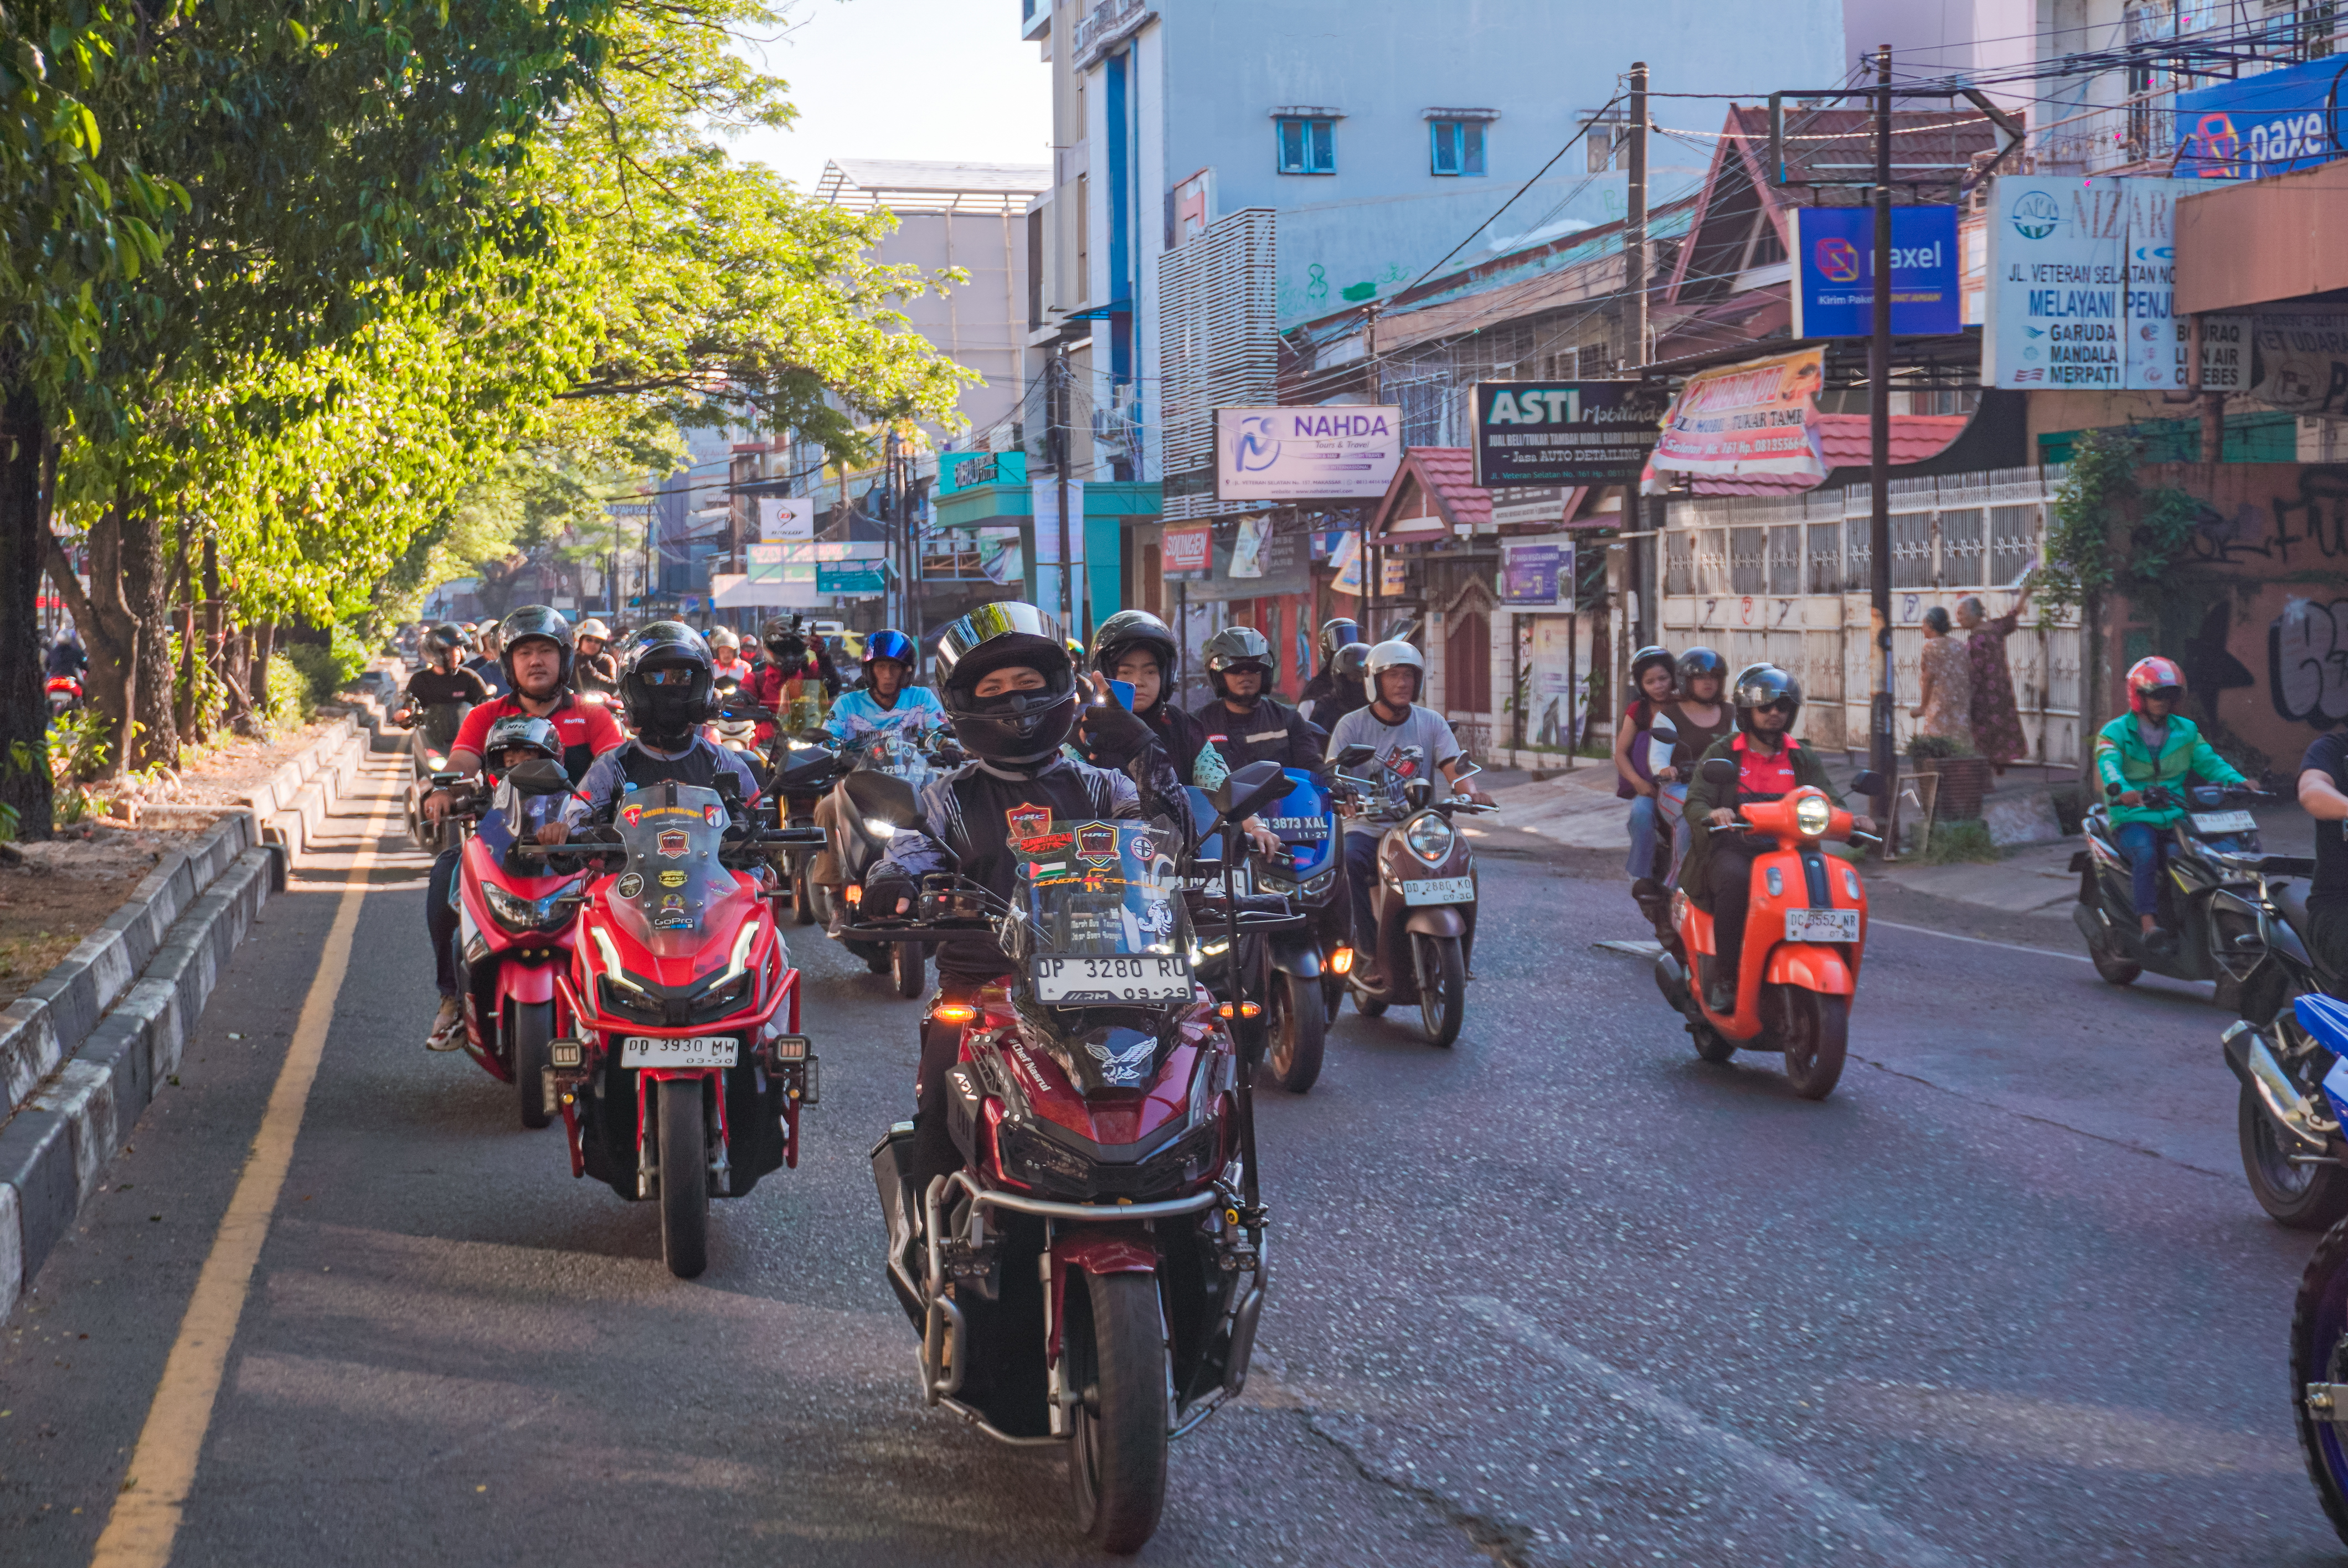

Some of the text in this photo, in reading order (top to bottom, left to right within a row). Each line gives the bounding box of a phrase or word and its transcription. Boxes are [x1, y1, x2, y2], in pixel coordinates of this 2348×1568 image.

[2031, 264, 2090, 283] VETERAN
[2094, 265, 2155, 284] SELATAN
[1818, 295, 1846, 305] Kirim
[2028, 289, 2117, 318] MELAYANI
[2050, 323, 2118, 342] GARUDA
[2050, 345, 2119, 364] MANDALA
[2216, 348, 2239, 366] AIR
[2050, 365, 2120, 384] MERPATI
[1486, 388, 1580, 425] ASTI
[1295, 415, 1390, 437] NAHDA
[1316, 440, 1371, 449] Tours & Travel
[1489, 434, 1506, 447] JUAL
[1551, 433, 1579, 446] TAMBAH
[1579, 432, 1602, 445] MOBIL
[1665, 439, 1702, 455] Selatan
[1512, 448, 1641, 463] Jasa AUTO DETAILING
[1502, 471, 1532, 479] Veteran
[1533, 470, 1562, 479] Selatan
[1165, 532, 1208, 557] SOLINGEN
[1272, 817, 1302, 829] 3873
[1304, 817, 1329, 829] XAL
[1032, 877, 1082, 889] HONDA
[1405, 883, 1419, 893] DD
[1809, 914, 1836, 926] 3552
[1843, 914, 1856, 926] NR
[1038, 958, 1188, 978] DP 3280 RU
[629, 1039, 735, 1053] DD 3930 MW
[953, 1072, 979, 1101] ADV
